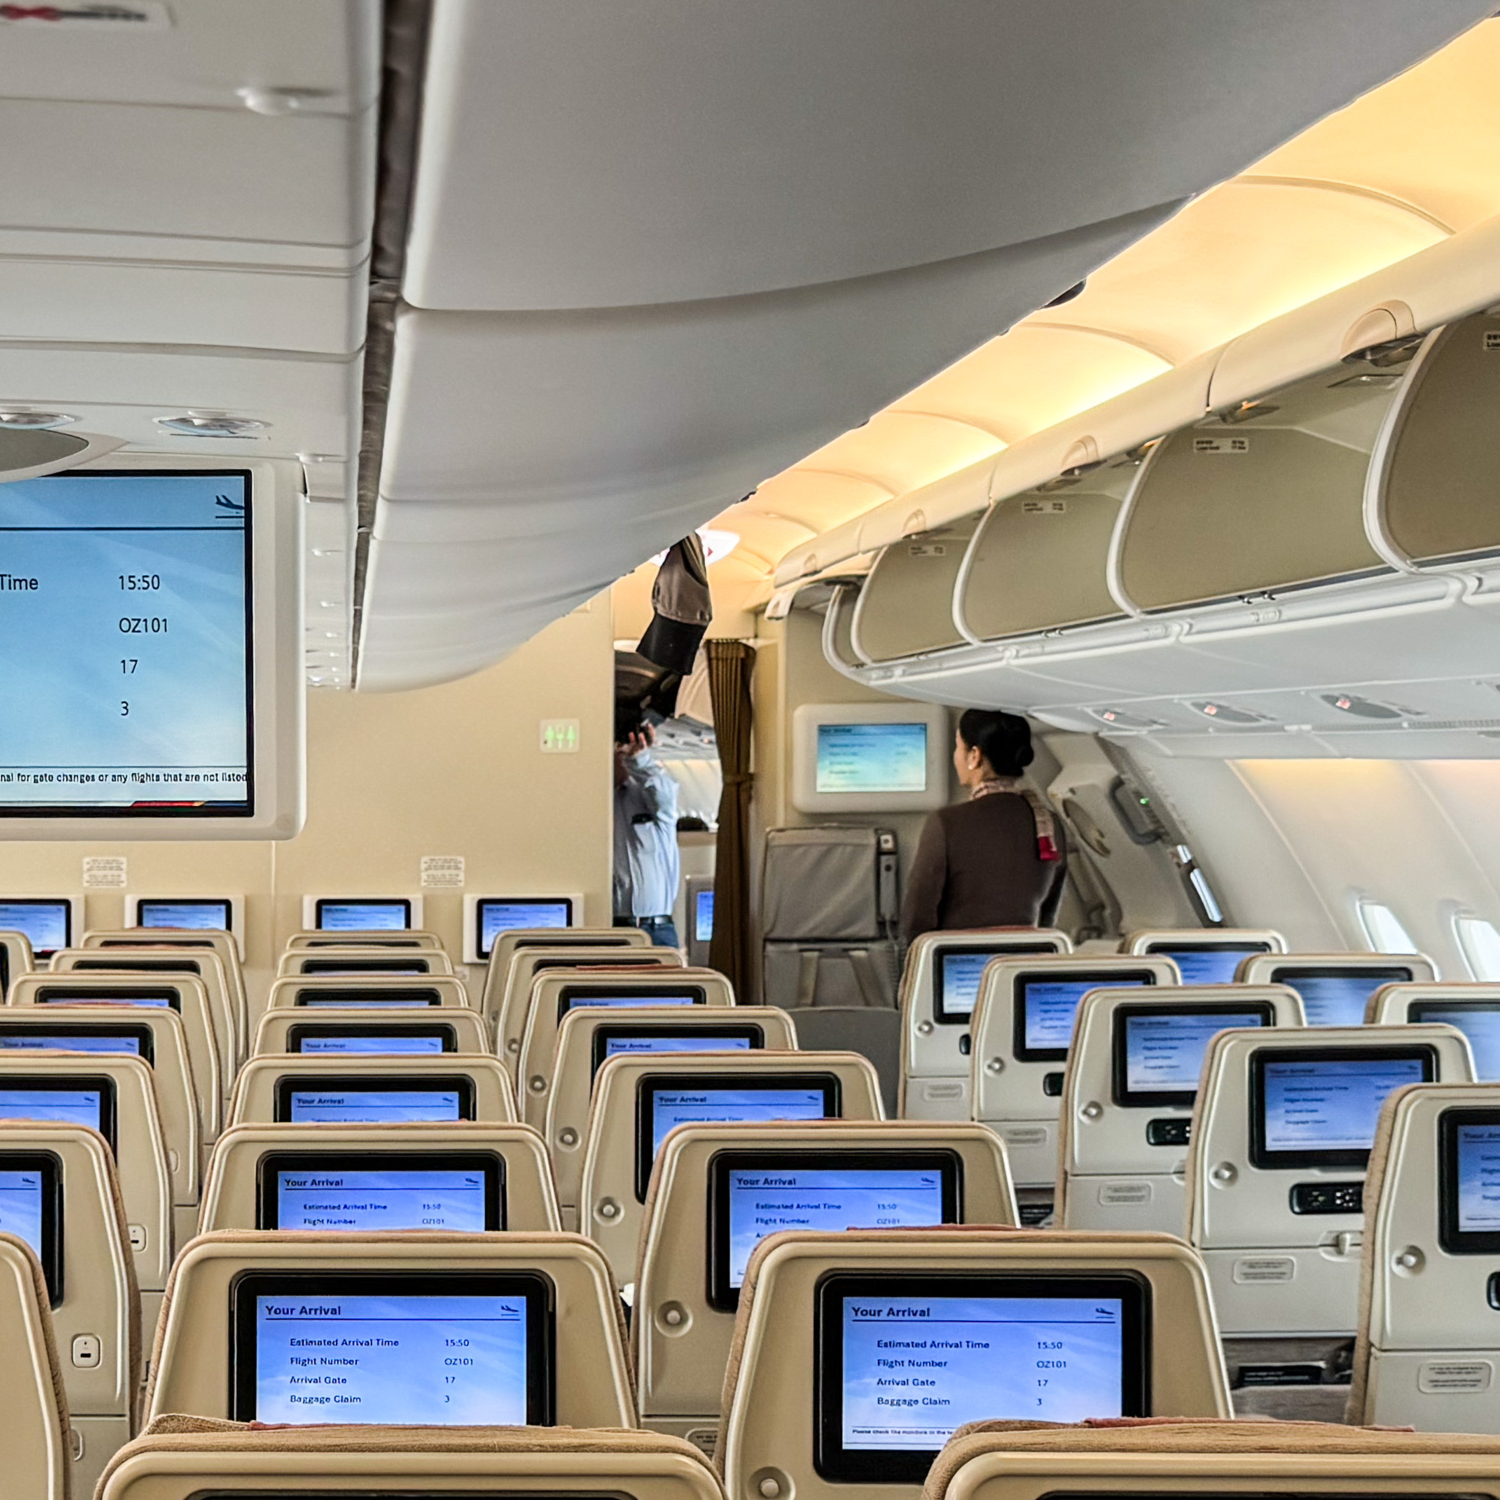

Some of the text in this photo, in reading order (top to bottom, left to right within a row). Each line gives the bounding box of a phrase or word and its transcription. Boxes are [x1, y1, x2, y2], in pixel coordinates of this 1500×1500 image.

[118, 574, 160, 590] 15:50
[118, 617, 167, 633] OZ101
[120, 659, 138, 674] 17
[120, 700, 129, 716] 3
[16, 772, 31, 782] for
[32, 773, 54, 784] gate
[56, 773, 95, 784] changes
[98, 774, 108, 782] or
[111, 774, 128, 784] any
[130, 772, 160, 783] flights
[162, 772, 182, 782] that
[184, 773, 200, 782] are
[202, 772, 218, 782] not
[284, 1178, 343, 1187] Your Arrival
[736, 1177, 796, 1185] Your Arrival
[264, 1305, 340, 1315] Your Arrival
[851, 1306, 930, 1317] Your Arrival
[876, 1339, 1063, 1349] Estimated Arrival Time 15:50
[877, 1358, 1066, 1369] Flight Number OZ101
[876, 1377, 909, 1386] Arrival
[912, 1378, 936, 1386] Gate
[876, 1396, 1042, 1407] Baggage Claim 3
